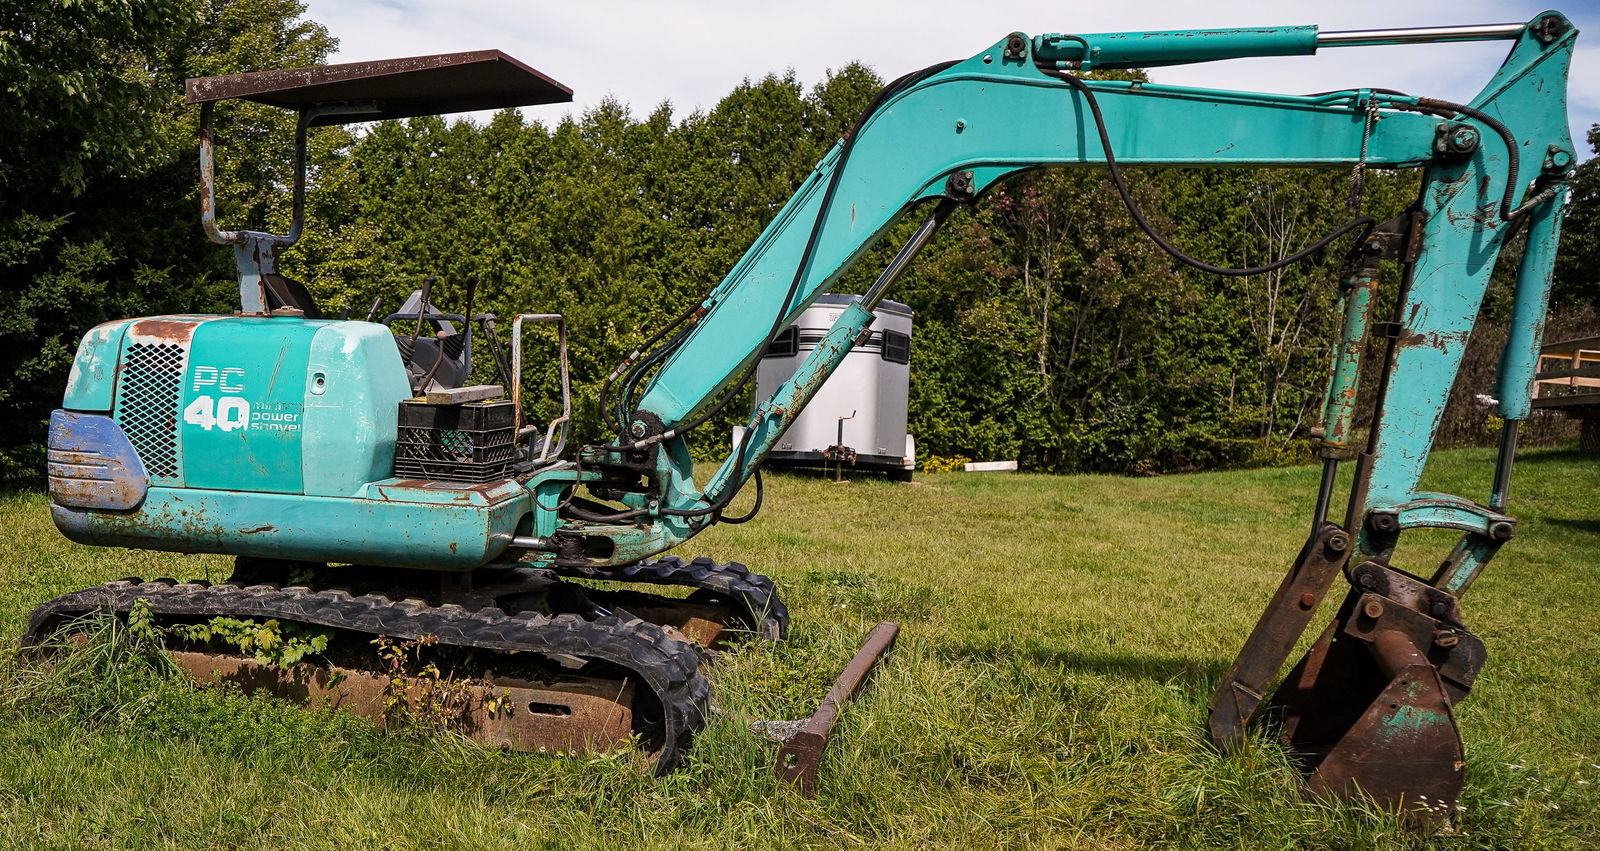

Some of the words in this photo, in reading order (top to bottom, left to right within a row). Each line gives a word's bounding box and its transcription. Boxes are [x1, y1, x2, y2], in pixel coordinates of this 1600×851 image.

[193, 366, 245, 393] PC
[184, 395, 250, 432] 40
[252, 412, 299, 422] power
